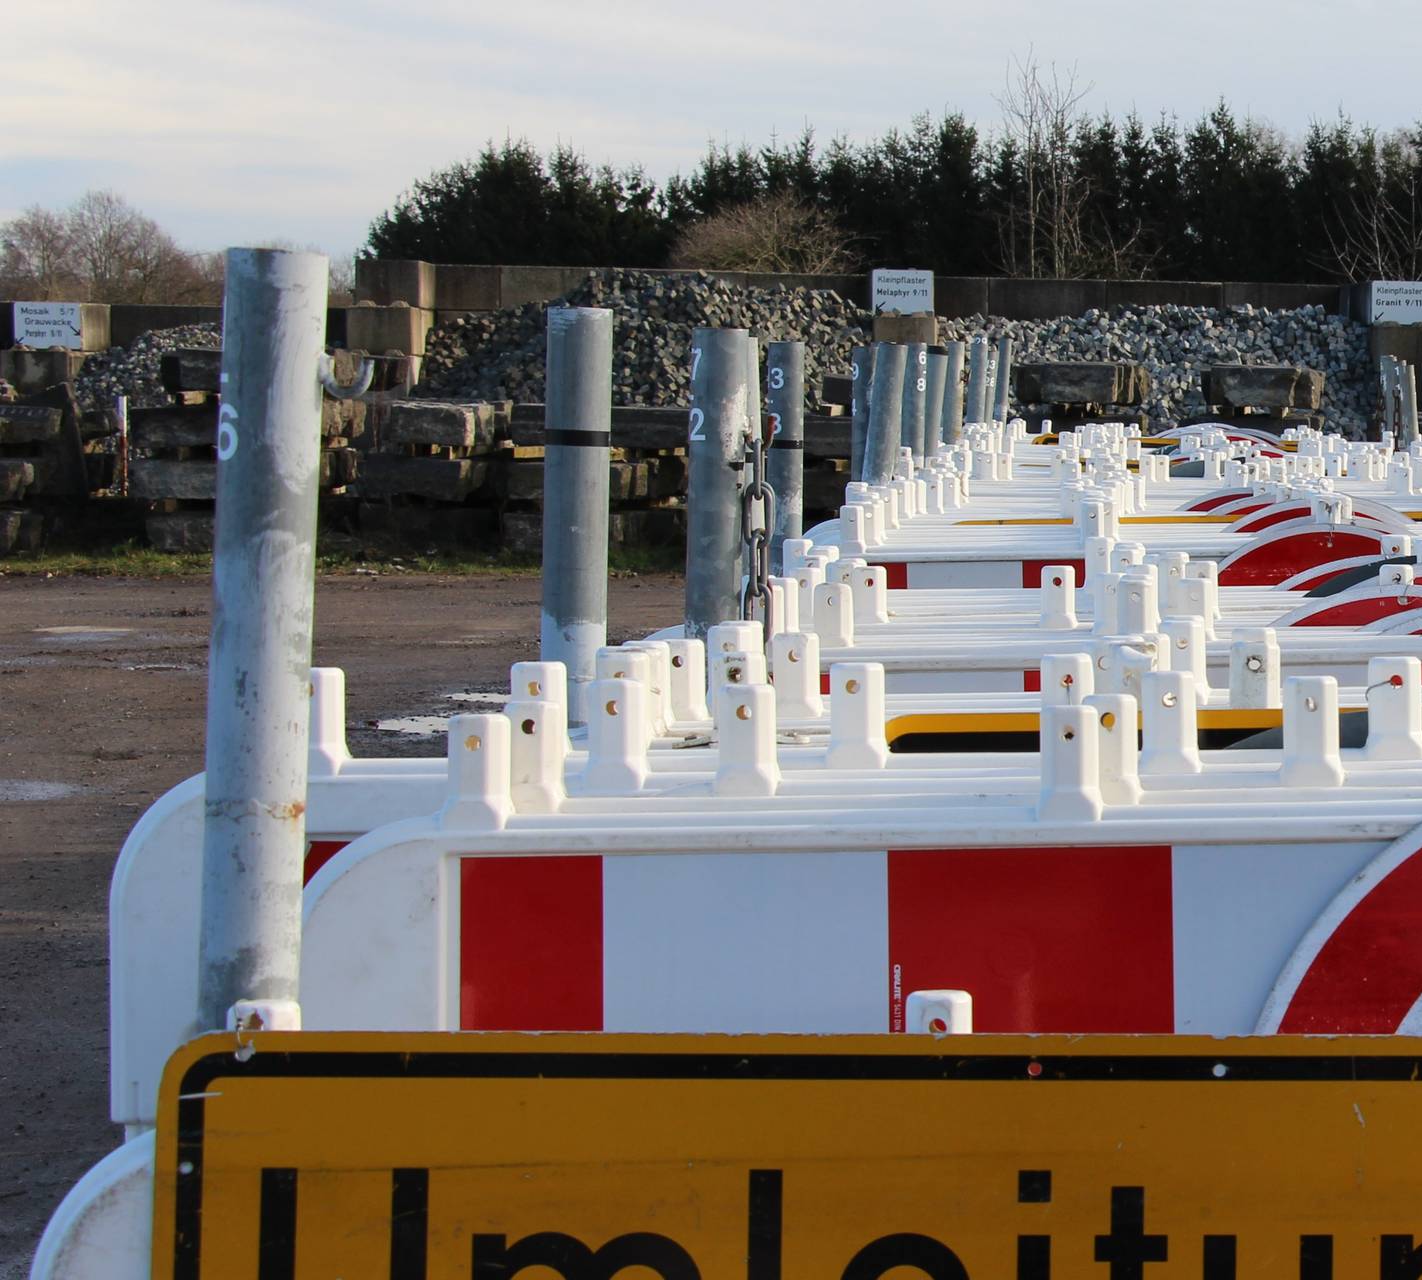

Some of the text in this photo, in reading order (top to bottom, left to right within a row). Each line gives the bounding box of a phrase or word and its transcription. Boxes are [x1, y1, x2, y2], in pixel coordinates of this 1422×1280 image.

[878, 276, 926, 285] Kleinpflaster
[876, 288, 928, 298] Melaphyr 9/11
[1376, 287, 1422, 295] Kleinpflaster
[1375, 298, 1422, 307] Granit 9/11
[20, 307, 75, 315] Mosaik 5/7
[24, 317, 72, 326] Grauwacke
[689, 407, 706, 441] 2
